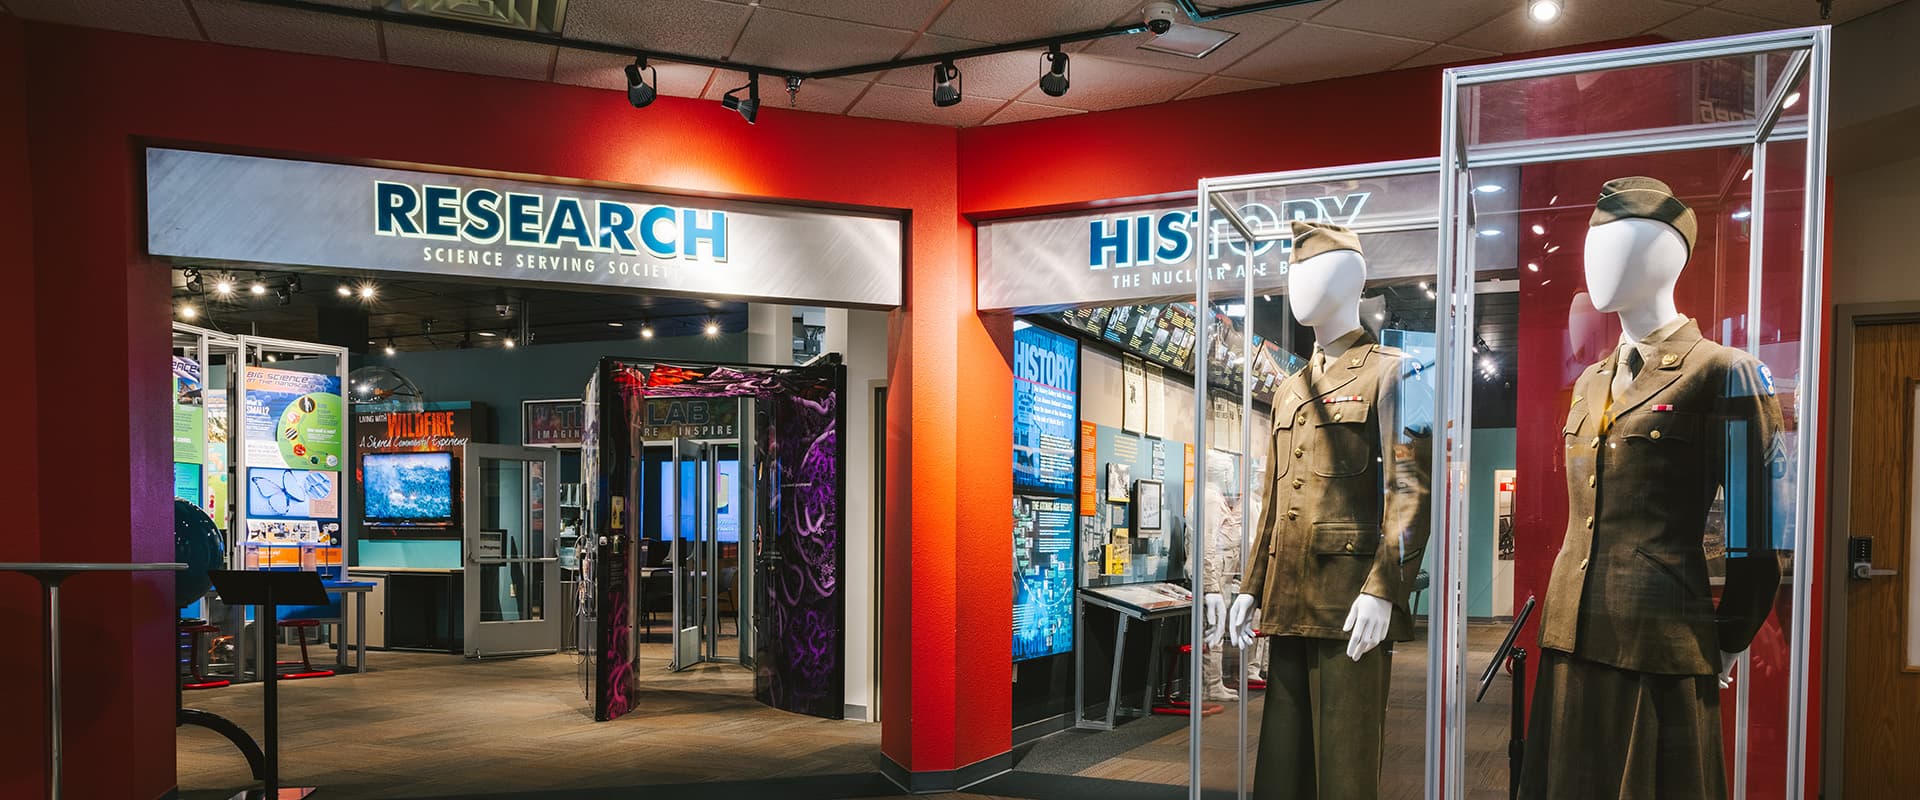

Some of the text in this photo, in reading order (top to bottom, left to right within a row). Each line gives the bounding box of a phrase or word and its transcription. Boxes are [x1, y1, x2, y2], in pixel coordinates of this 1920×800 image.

[374, 180, 729, 263] RESEARCH
[423, 247, 680, 280] SCIENCE SERVING SOCIET
[1113, 275, 1141, 288] THE
[1014, 340, 1074, 391] HISTORY
[359, 415, 374, 423] LIVING
[387, 411, 455, 438] WILDFIRE
[647, 400, 711, 426] LAB
[537, 425, 733, 440] IMAGIN INSPIRE
